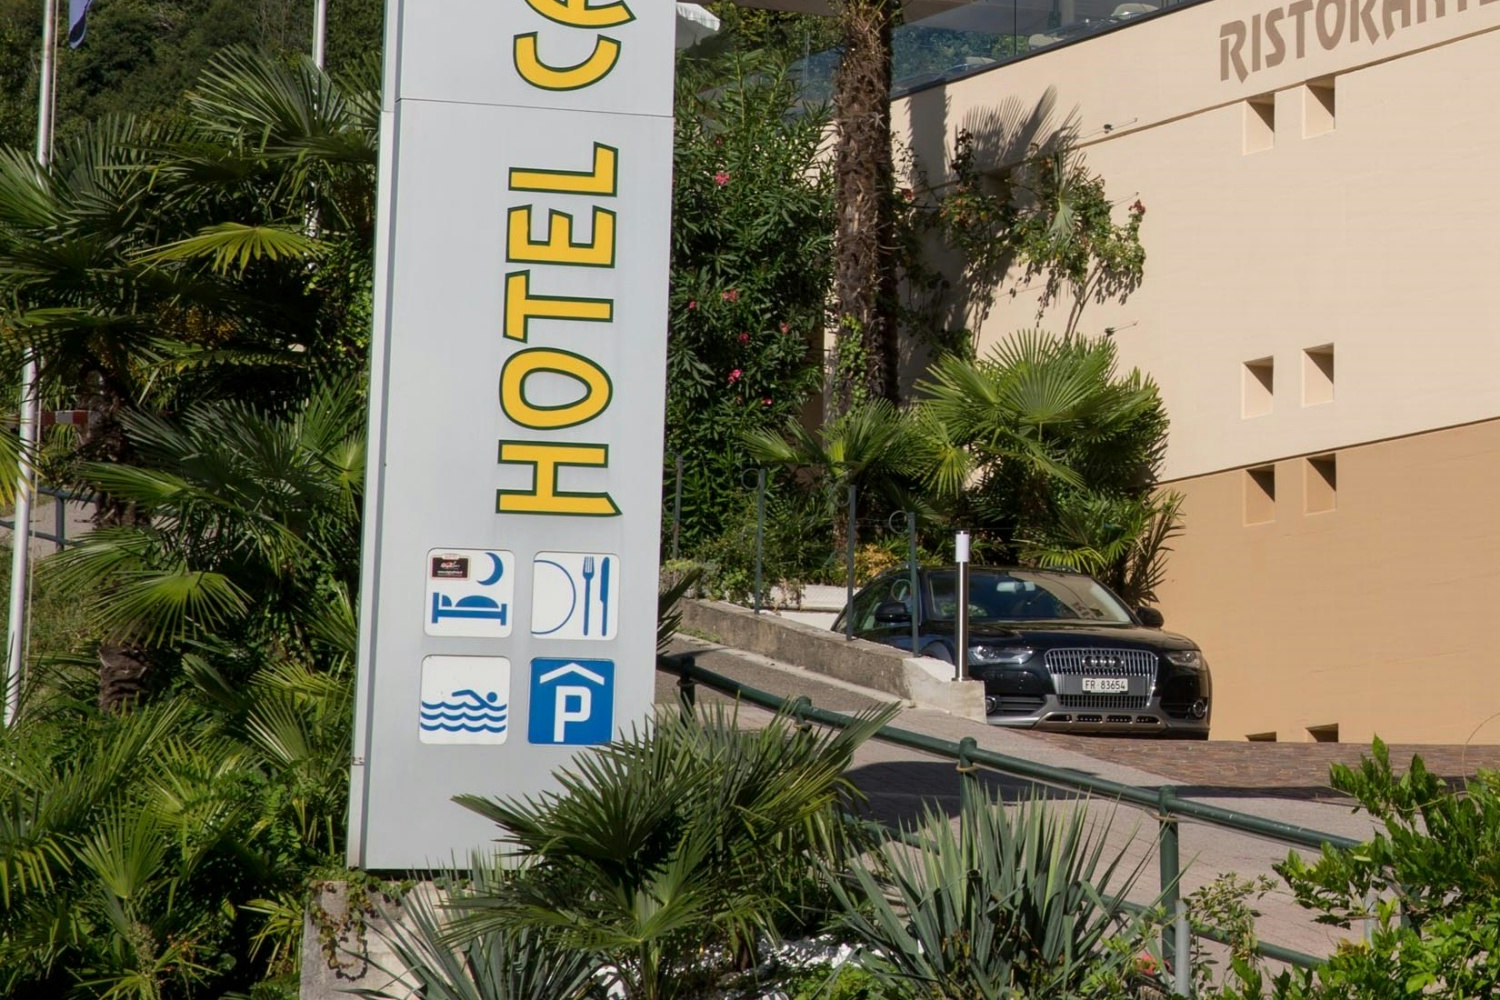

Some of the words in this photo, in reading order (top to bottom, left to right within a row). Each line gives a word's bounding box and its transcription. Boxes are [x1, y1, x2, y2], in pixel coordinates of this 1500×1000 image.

[495, 140, 623, 518] HOTEL
[553, 685, 592, 742] P
[1085, 680, 1096, 690] FR
[1100, 680, 1126, 690] 83654
